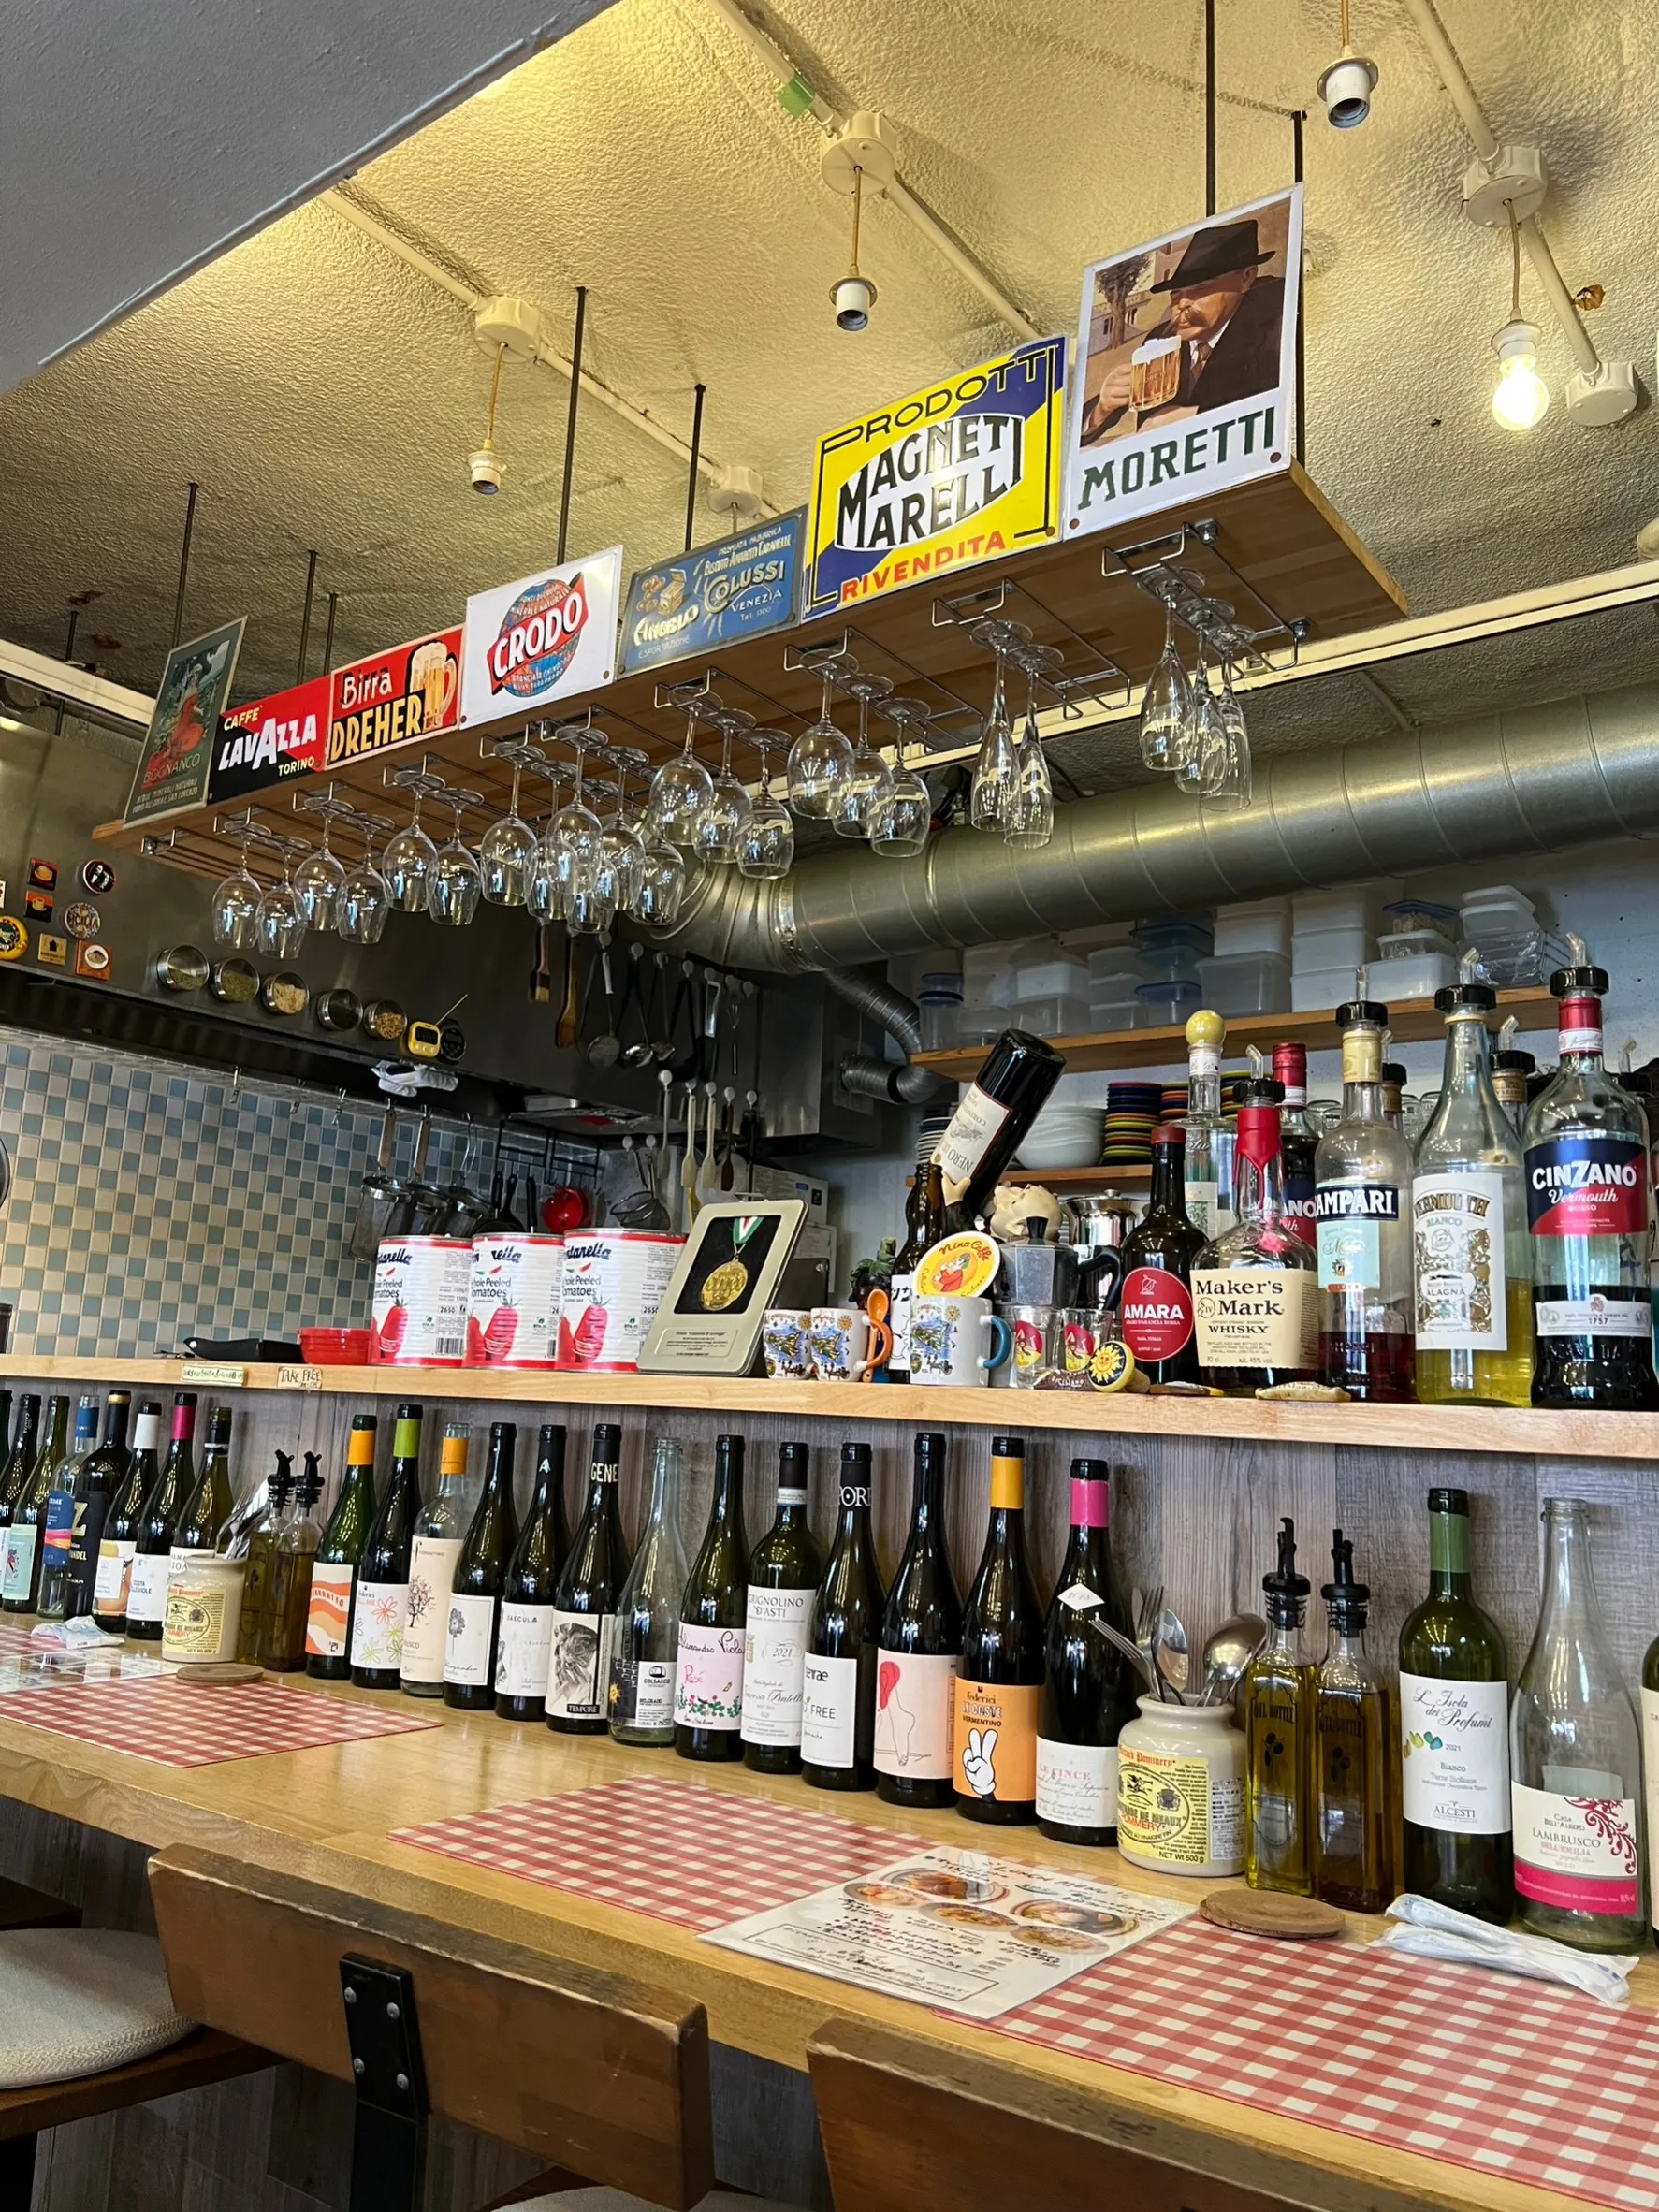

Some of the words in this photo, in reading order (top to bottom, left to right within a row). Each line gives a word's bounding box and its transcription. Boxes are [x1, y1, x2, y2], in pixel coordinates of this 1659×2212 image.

[822, 345, 1057, 456] PRODOTTI
[1077, 406, 1275, 511] MORETTI
[842, 530, 1007, 602] RIVENDITA
[704, 560, 785, 614] COLUSSI
[731, 589, 783, 612] VENEZIA
[633, 604, 699, 647] ANGELO
[493, 591, 583, 678] CRODO
[342, 671, 392, 709] Birra
[330, 694, 423, 763] DREHER
[218, 713, 317, 771] LAVAZZA
[278, 755, 315, 777] TORINO
[947, 1149, 974, 1172] NERO
[1532, 1159, 1637, 1189] CINZANO
[1316, 1189, 1396, 1215] AMPARI
[1548, 1189, 1619, 1204] Vermouth
[1426, 1216, 1463, 1228] BIANCO
[383, 1278, 402, 1288] Peeled
[486, 1277, 511, 1288] Peeled
[575, 1275, 601, 1286] Peeled
[1196, 1279, 1283, 1295] Maker's
[472, 1288, 507, 1298] omatoes
[562, 1287, 596, 1297] omatoes
[1426, 1288, 1466, 1297] ALAGNA
[1124, 1304, 1185, 1319] AMARA
[1217, 1300, 1284, 1316] Mark
[1208, 1325, 1269, 1333] WHISKY
[282, 1369, 299, 1382] TAKE
[302, 1369, 321, 1382] FREE
[772, 1648, 793, 1658] 2021
[685, 1664, 704, 1684] Rosé
[967, 1691, 997, 1704] federici
[1435, 1690, 1469, 1708] Isola
[810, 1705, 837, 1719] FREE
[971, 1703, 1002, 1718] COSTE
[1254, 1702, 1266, 1718] OIL
[1270, 1704, 1294, 1724] BOTTLE
[963, 1715, 1002, 1726] VERMENTINO
[1425, 1705, 1439, 1717] dei
[1438, 1708, 1492, 1732] Profumi
[1445, 1743, 1462, 1752] 2021
[1136, 1752, 1172, 1767] Pommery
[1440, 1762, 1466, 1772] Bianco
[1433, 1806, 1476, 1818] ALCESTI
[1152, 1813, 1182, 1827] MEAUX
[1532, 1827, 1601, 1848] LAMBRUSCO
